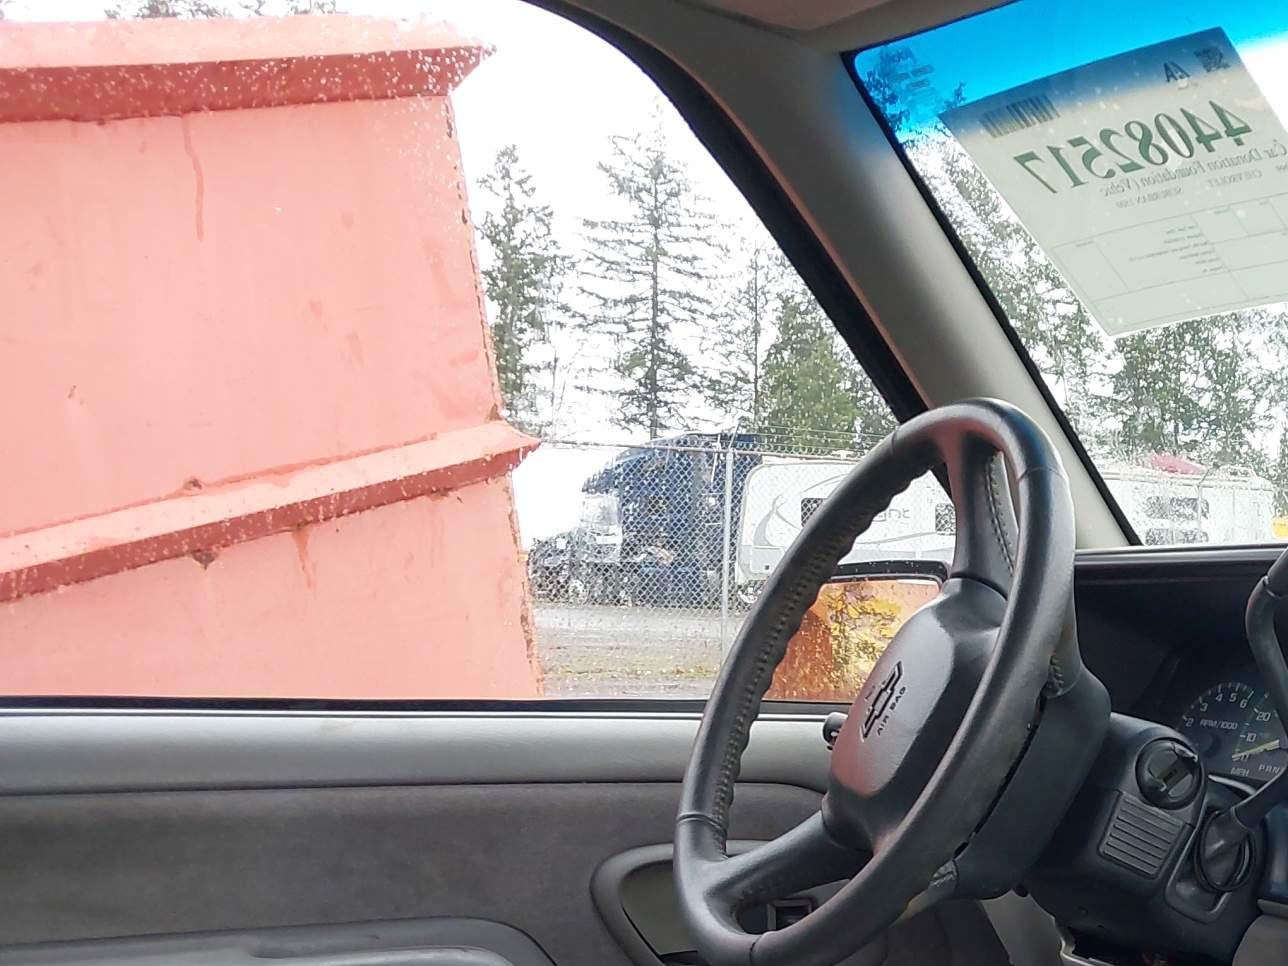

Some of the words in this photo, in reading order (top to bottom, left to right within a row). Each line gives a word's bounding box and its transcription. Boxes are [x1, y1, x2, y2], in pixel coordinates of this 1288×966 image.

[1215, 693, 1224, 702] 4
[1229, 693, 1238, 703] 5
[1240, 699, 1248, 709] 6
[1200, 702, 1209, 712] 3
[1256, 711, 1271, 722] 20
[1185, 717, 1194, 728] 2
[1246, 732, 1257, 743] 10
